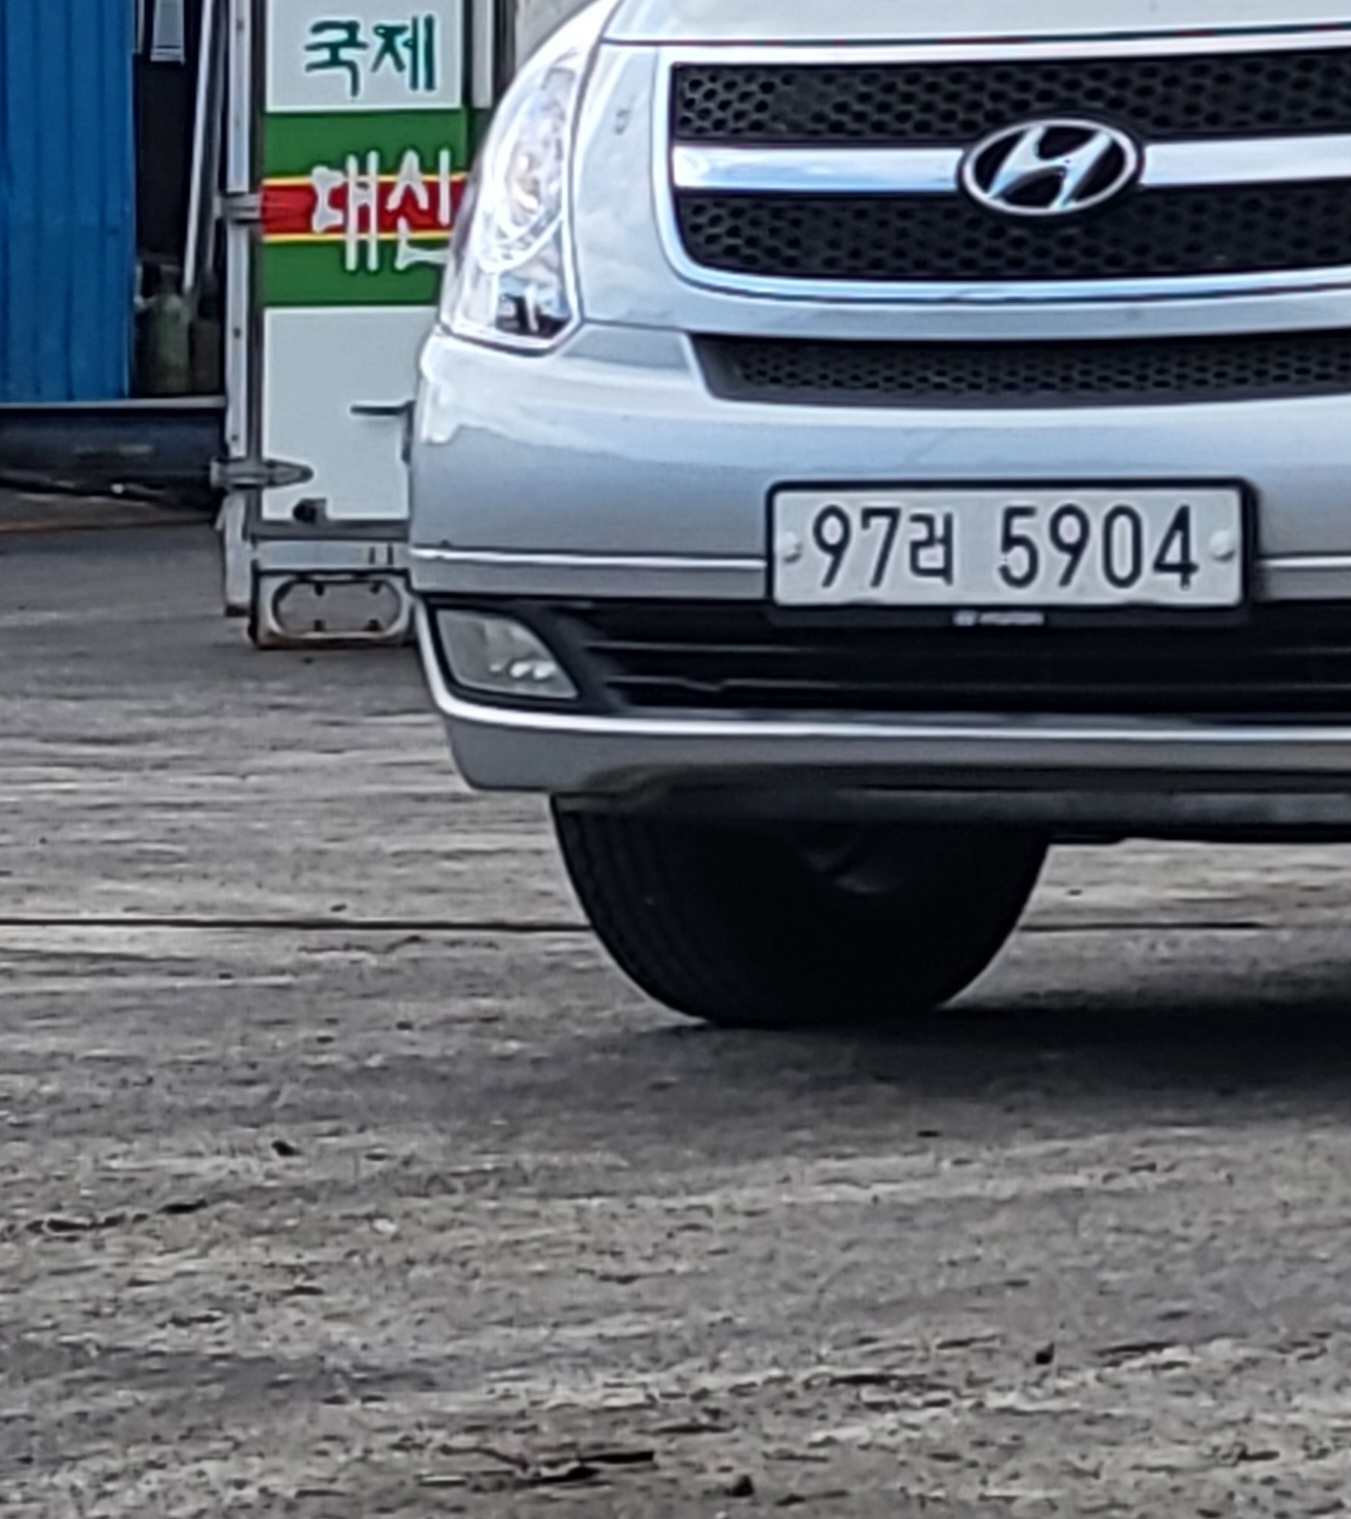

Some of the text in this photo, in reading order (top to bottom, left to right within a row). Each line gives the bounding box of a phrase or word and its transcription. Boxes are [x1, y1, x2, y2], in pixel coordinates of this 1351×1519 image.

[304, 14, 436, 98] 국제
[311, 147, 451, 271] 대신
[812, 504, 1199, 590] 97러 5904
